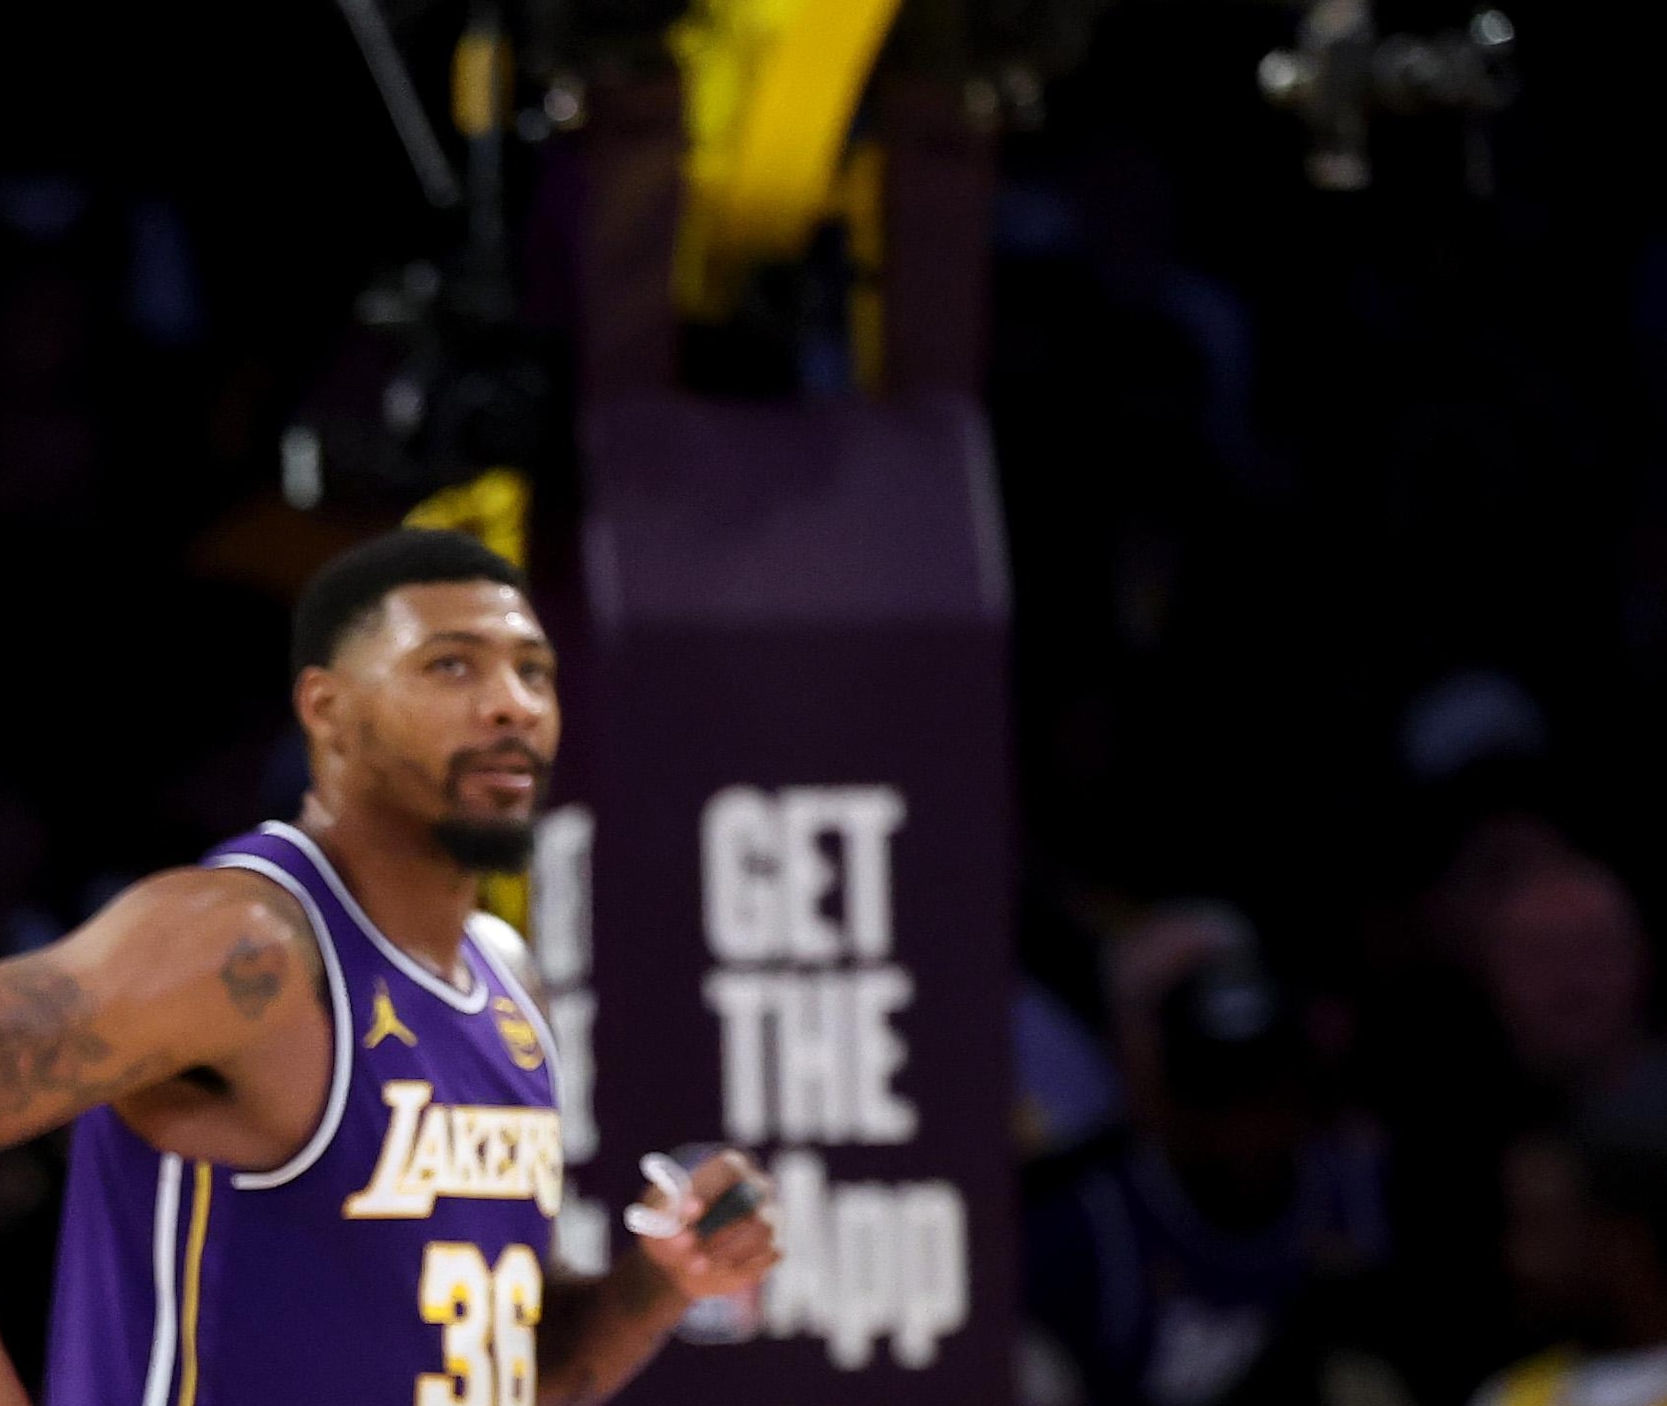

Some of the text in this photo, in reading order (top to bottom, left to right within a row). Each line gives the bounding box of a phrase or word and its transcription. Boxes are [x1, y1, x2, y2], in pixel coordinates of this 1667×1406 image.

[701, 784, 906, 960] GET
[703, 967, 917, 1146] THE
[341, 1078, 564, 1220] LAKER
[764, 1150, 969, 1371] App
